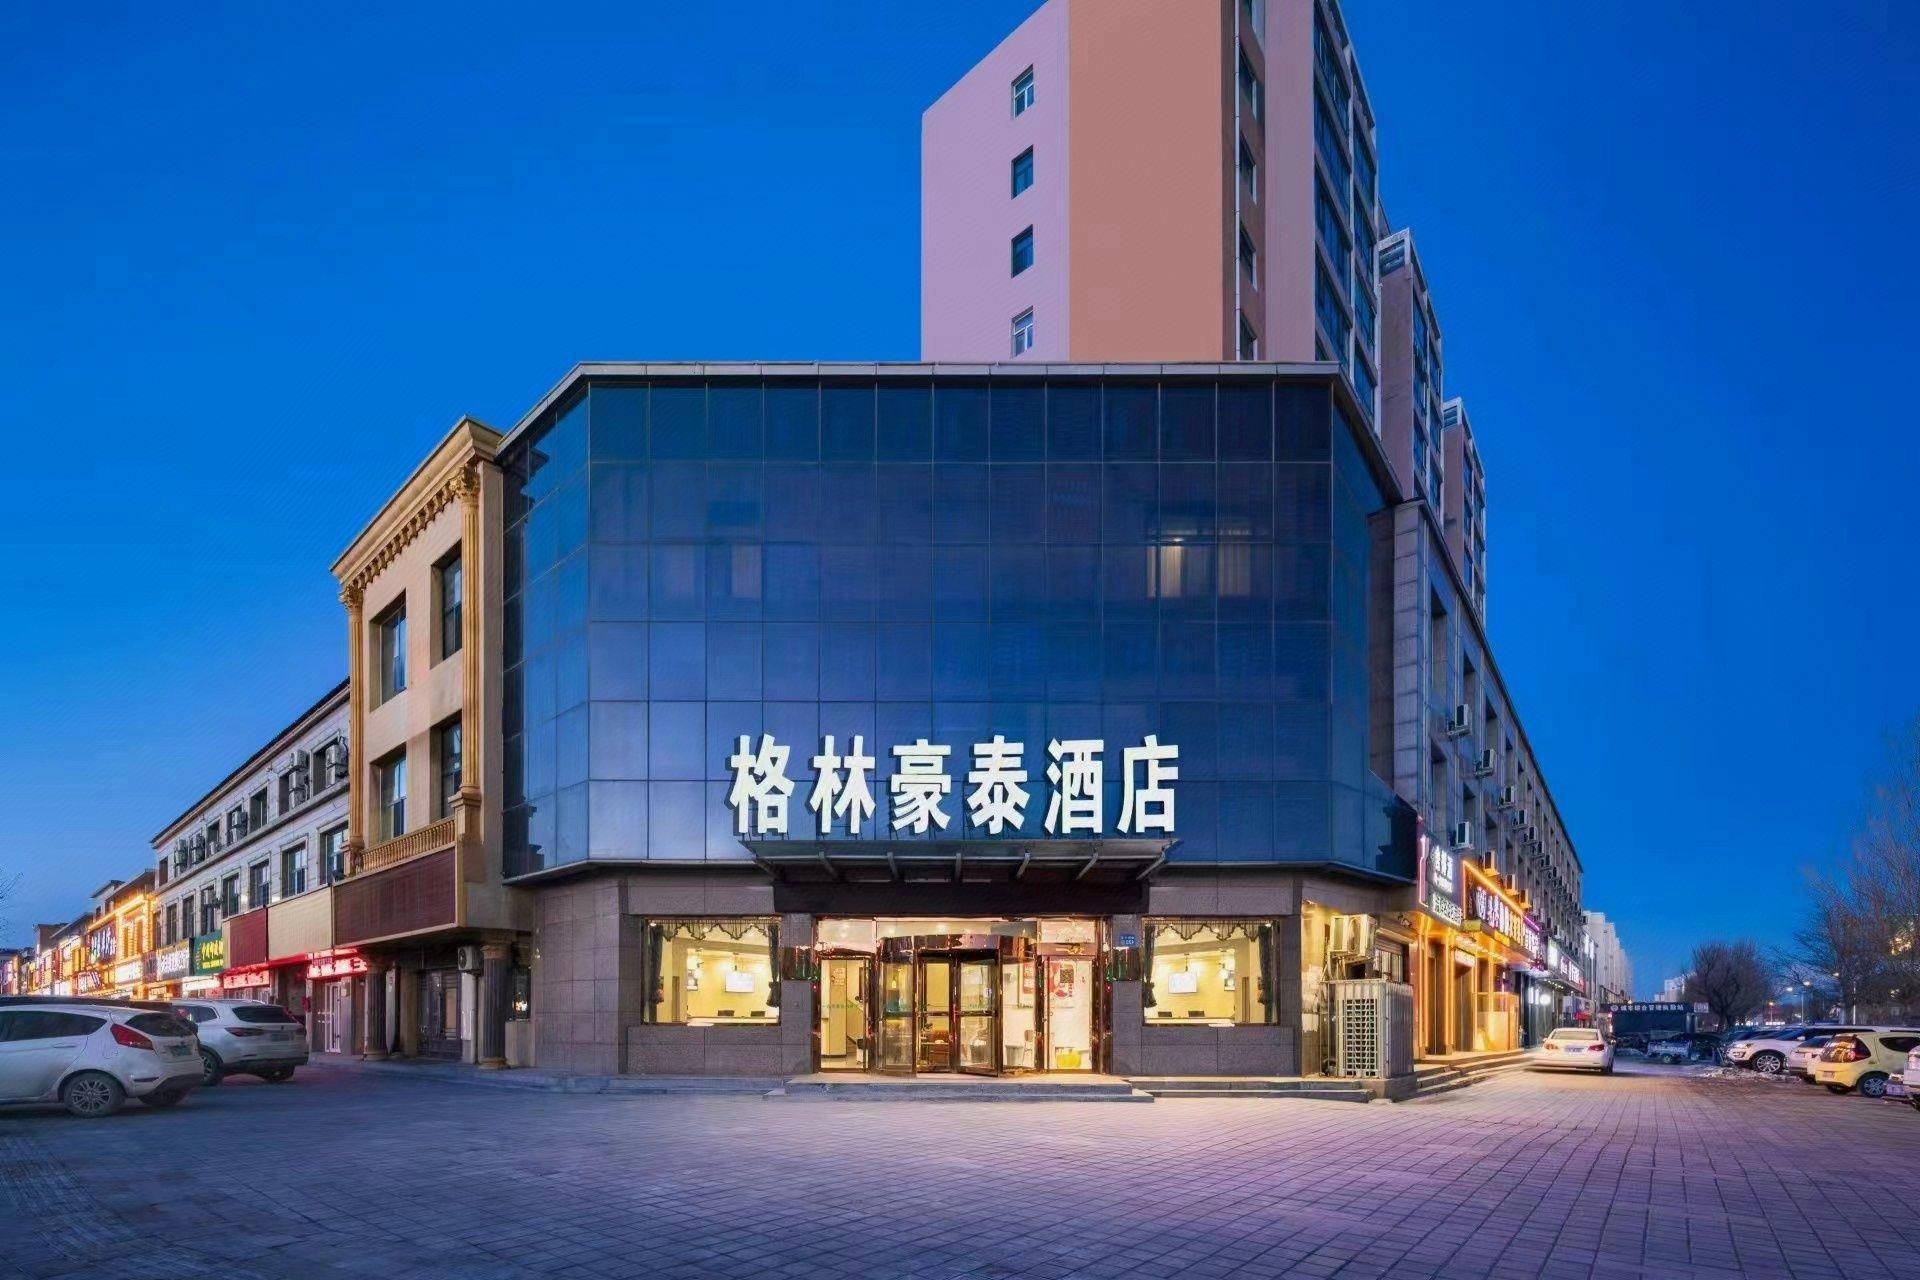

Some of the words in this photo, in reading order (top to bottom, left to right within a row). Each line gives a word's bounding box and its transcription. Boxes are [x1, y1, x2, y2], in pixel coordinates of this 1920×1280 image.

[730, 734, 1179, 834] 格林豪泰酒店
